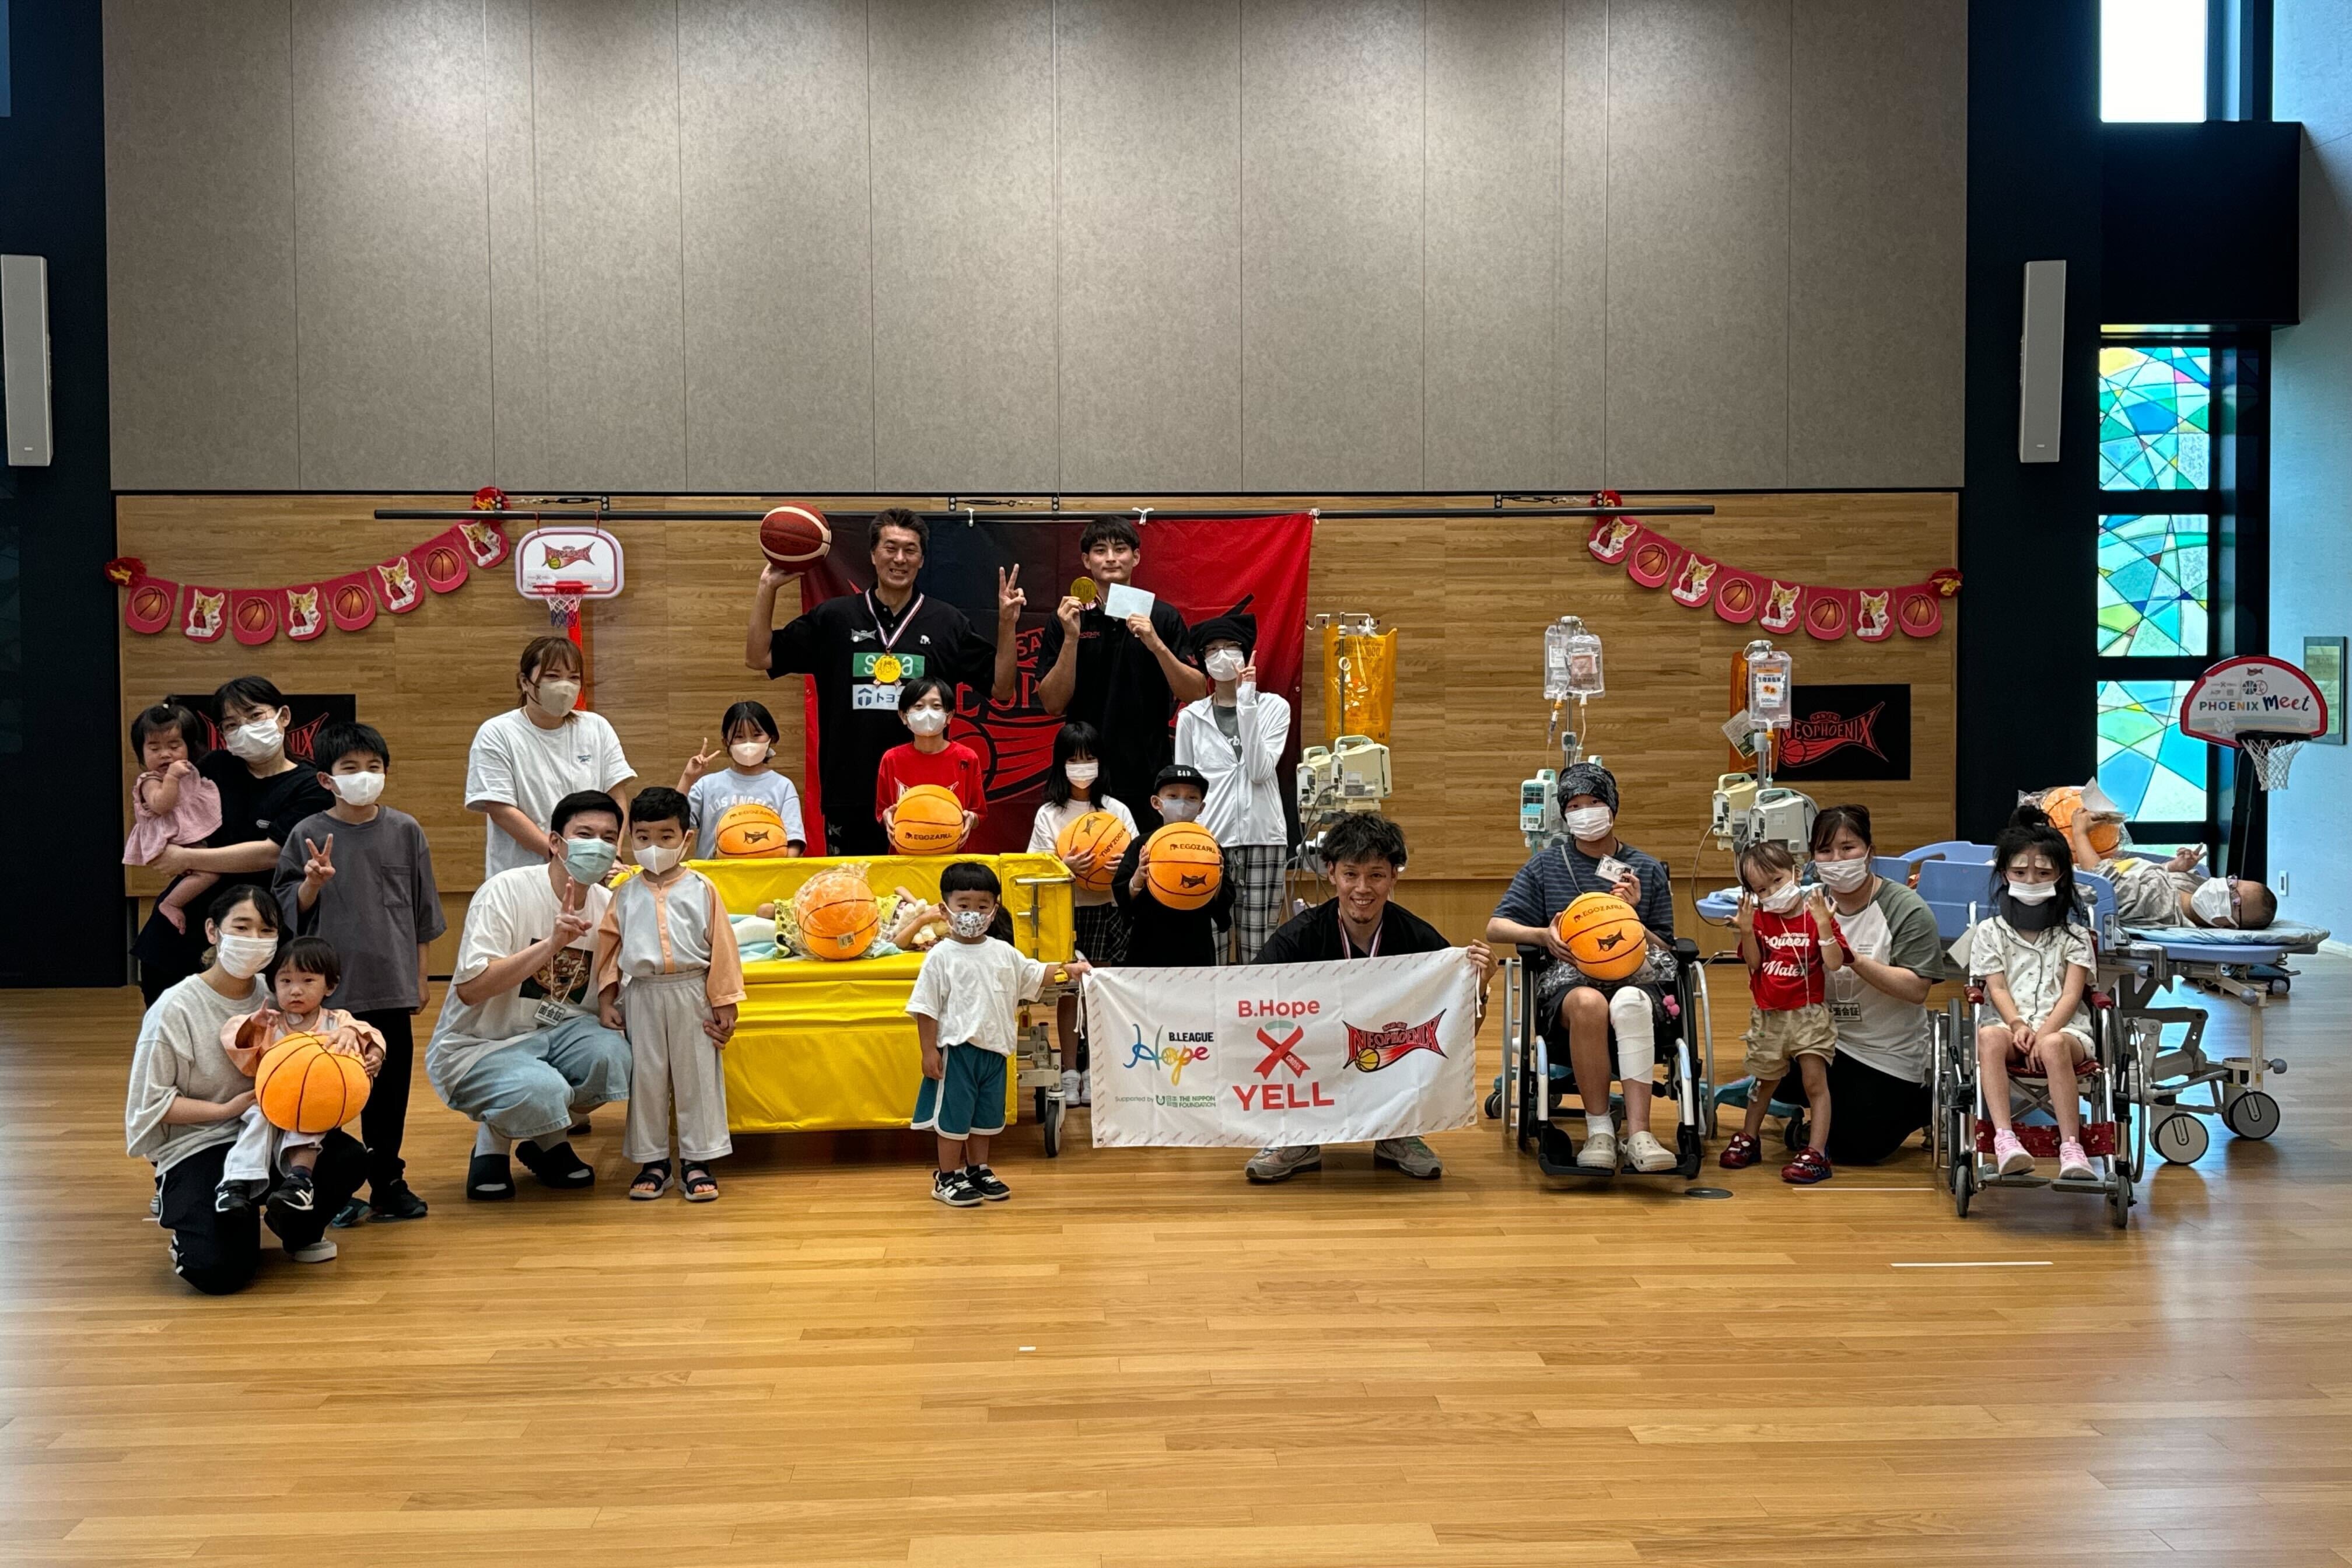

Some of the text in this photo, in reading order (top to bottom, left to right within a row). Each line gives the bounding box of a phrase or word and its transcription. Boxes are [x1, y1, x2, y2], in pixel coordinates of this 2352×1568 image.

[864, 654, 914, 677] sa
[2199, 701, 2259, 712] PHOENIX
[709, 796, 729, 814] LOS
[1238, 999, 1321, 1019] B.Hope
[1168, 1031, 1214, 1042] B.LEAGUE
[1122, 1023, 1210, 1086] Hope
[1232, 1082, 1335, 1111] YELL
